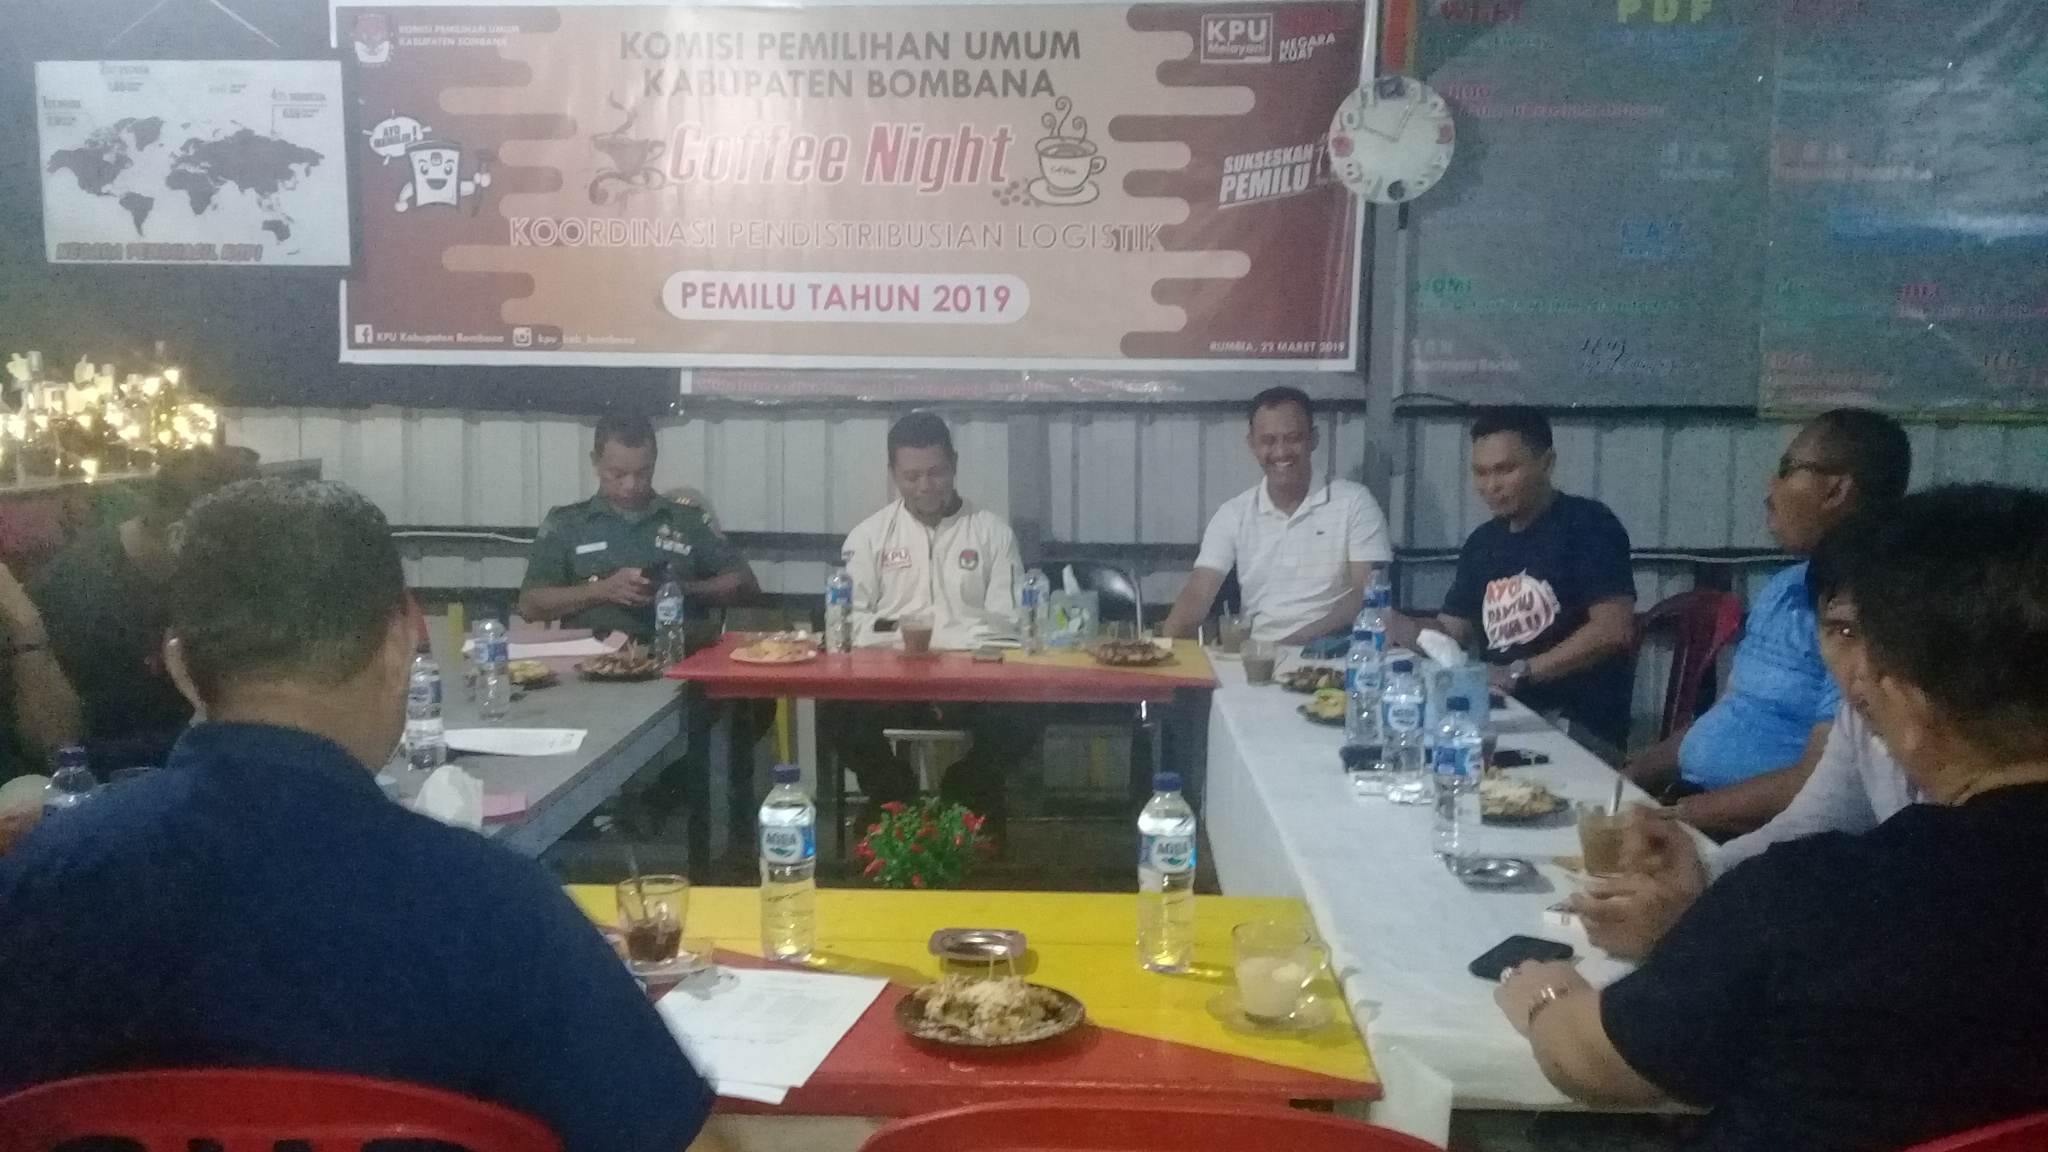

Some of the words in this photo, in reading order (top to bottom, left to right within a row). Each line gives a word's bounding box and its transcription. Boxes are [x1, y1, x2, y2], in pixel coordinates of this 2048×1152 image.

[620, 31, 744, 60] KOMISI
[758, 31, 950, 60] PEMILIHAN
[964, 30, 1081, 60] UMUM
[1207, 20, 1267, 42] KPU
[1279, 32, 1336, 51] NEGARA
[1279, 47, 1313, 62] KUAT
[643, 68, 853, 98] KABUPATEN
[867, 68, 1056, 98] BOMBANA
[667, 121, 850, 185] Coffee
[862, 122, 1014, 197] Night
[1223, 143, 1314, 175] SUKSESKAN
[1219, 162, 1312, 203] PEMILU
[509, 216, 717, 248] KOORDINASI
[728, 218, 1005, 250] PENDISTRIBUSIAN
[1016, 221, 1167, 252] LOGISTIK
[680, 281, 796, 311] PEMILU
[807, 283, 921, 312] TAHUN
[932, 284, 1012, 313] 2019
[376, 332, 397, 342] KPU
[1277, 341, 1316, 353] MARET
[1319, 341, 1346, 353] 2019
